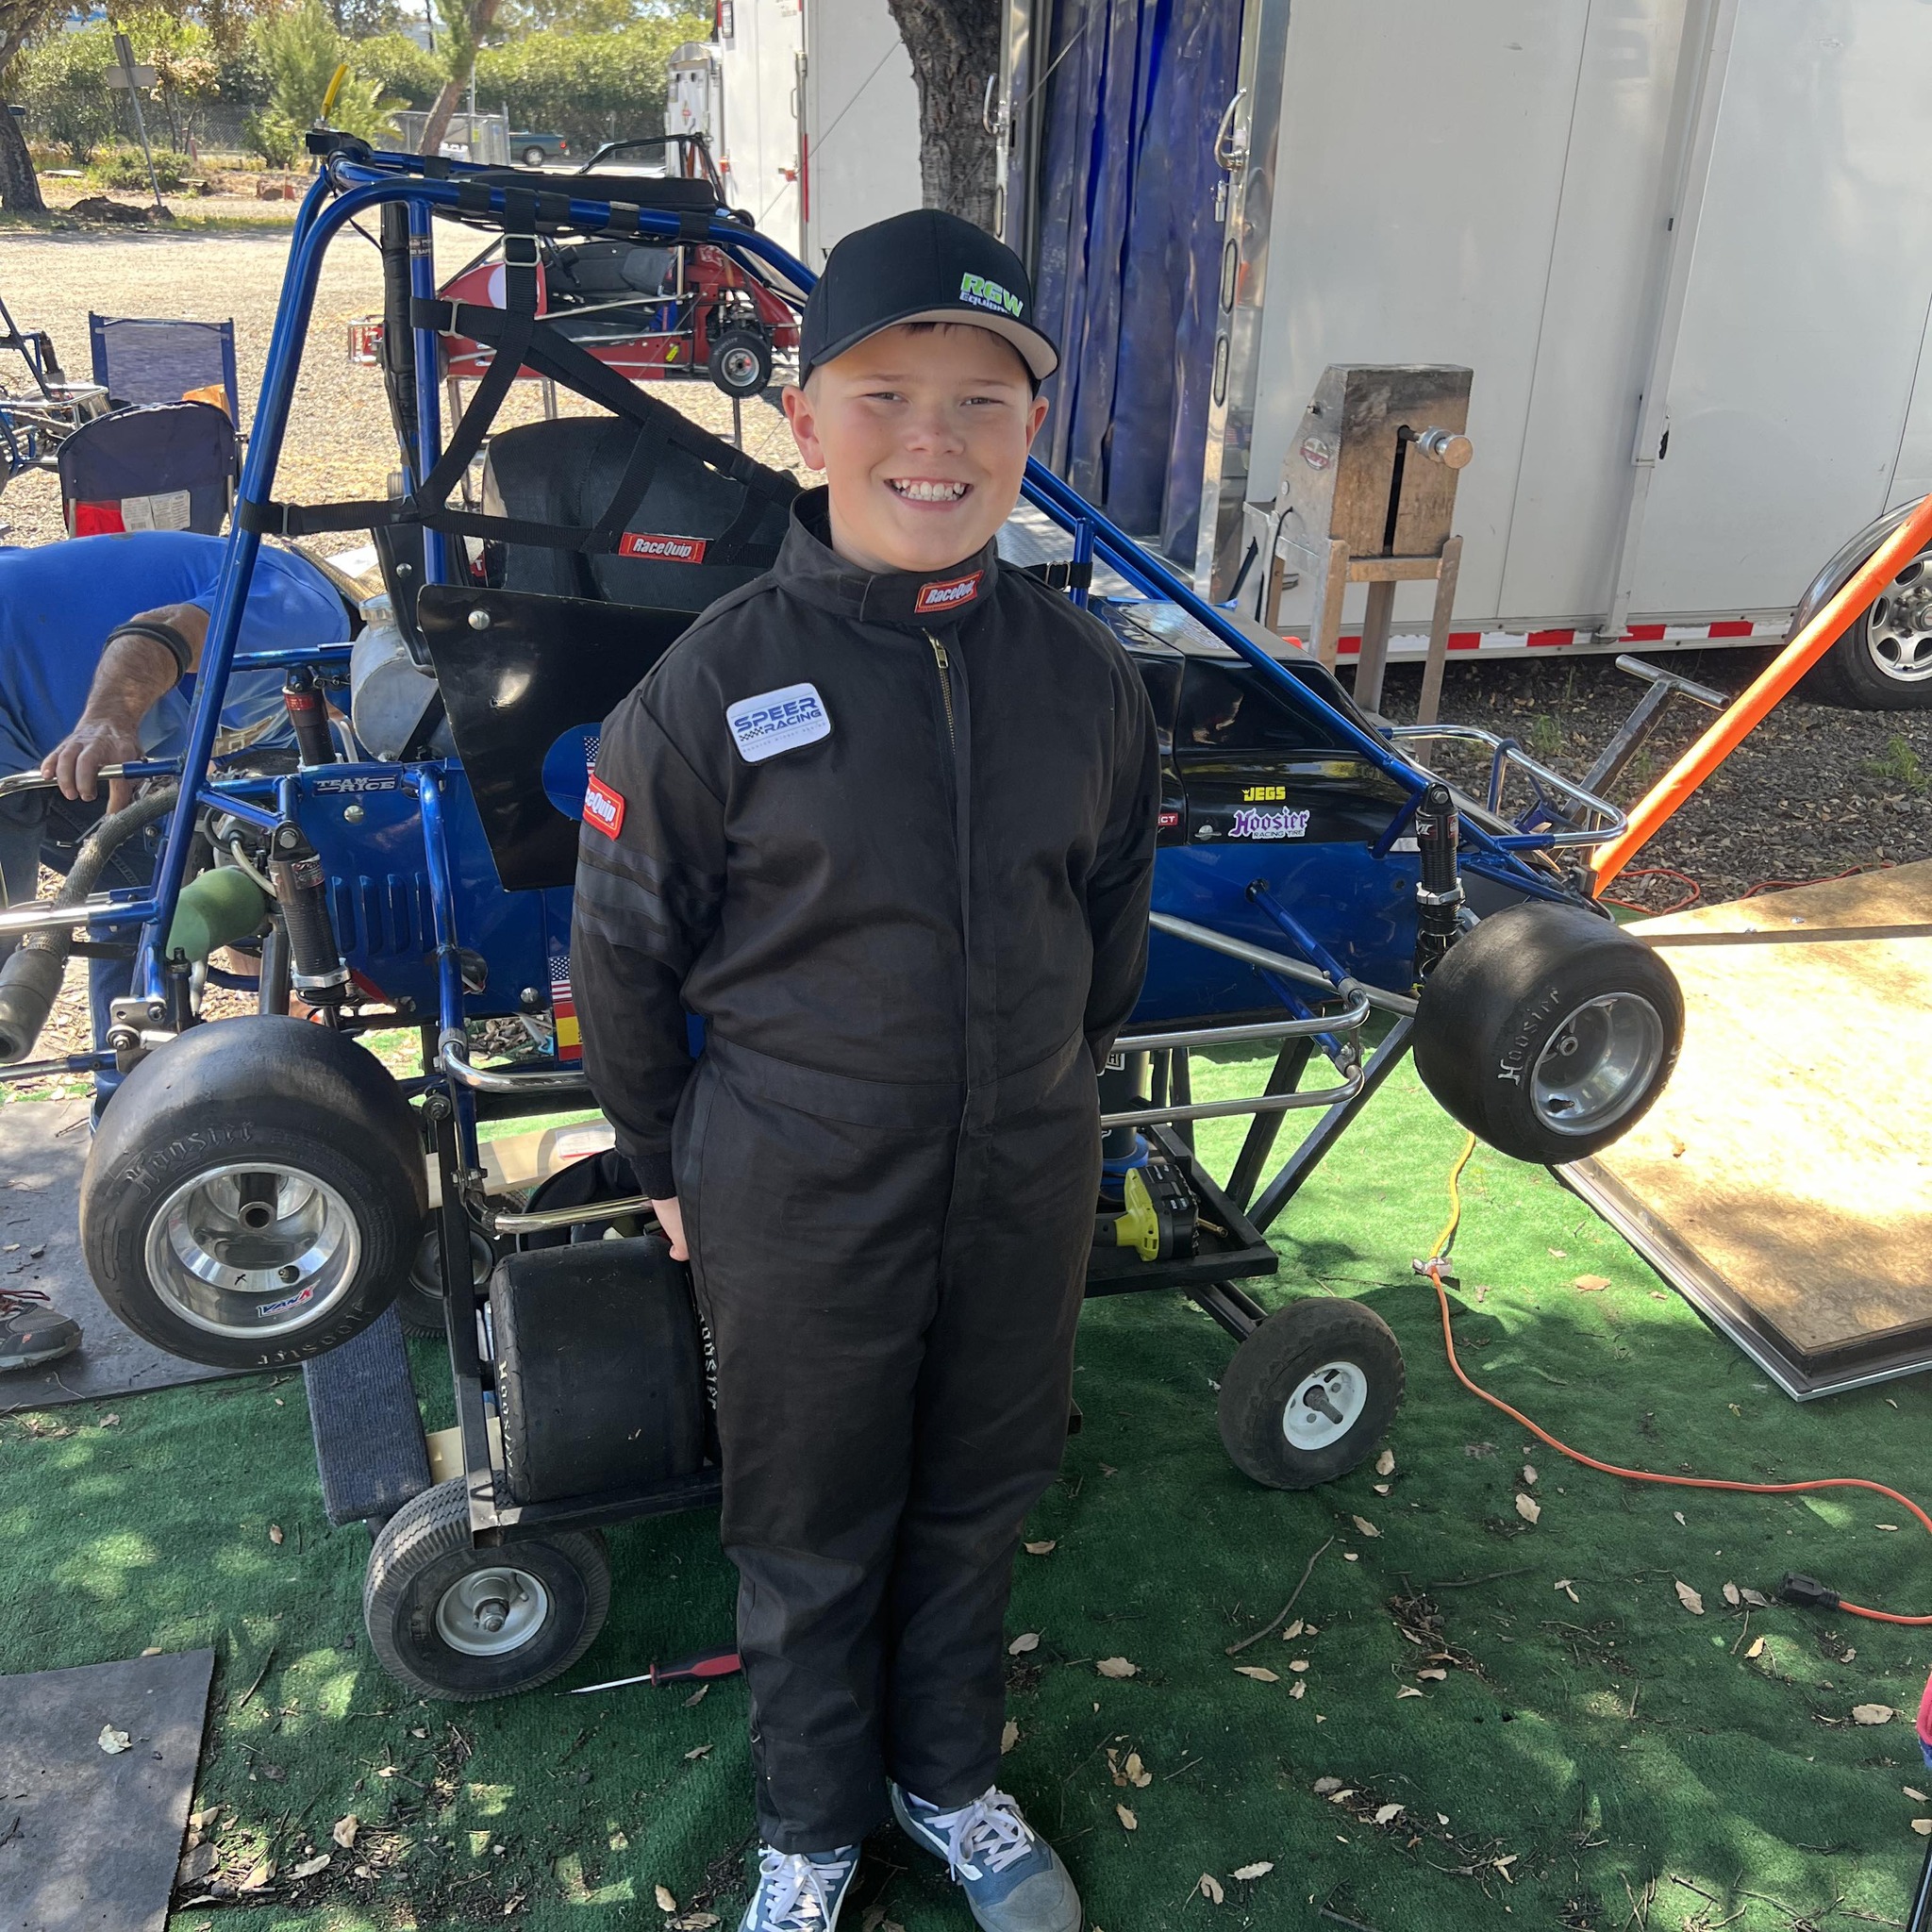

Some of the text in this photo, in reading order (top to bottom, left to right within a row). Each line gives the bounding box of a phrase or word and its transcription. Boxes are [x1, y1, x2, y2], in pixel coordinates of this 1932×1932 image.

[960, 273, 1024, 318] RGW
[633, 538, 692, 558] RaceQuip
[925, 579, 975, 604] RaceQui
[734, 697, 818, 733] SPEER
[763, 708, 822, 734] RACING
[316, 776, 370, 788] TEAM
[1242, 786, 1286, 802] JEGS
[1228, 806, 1310, 838] Hoosier
